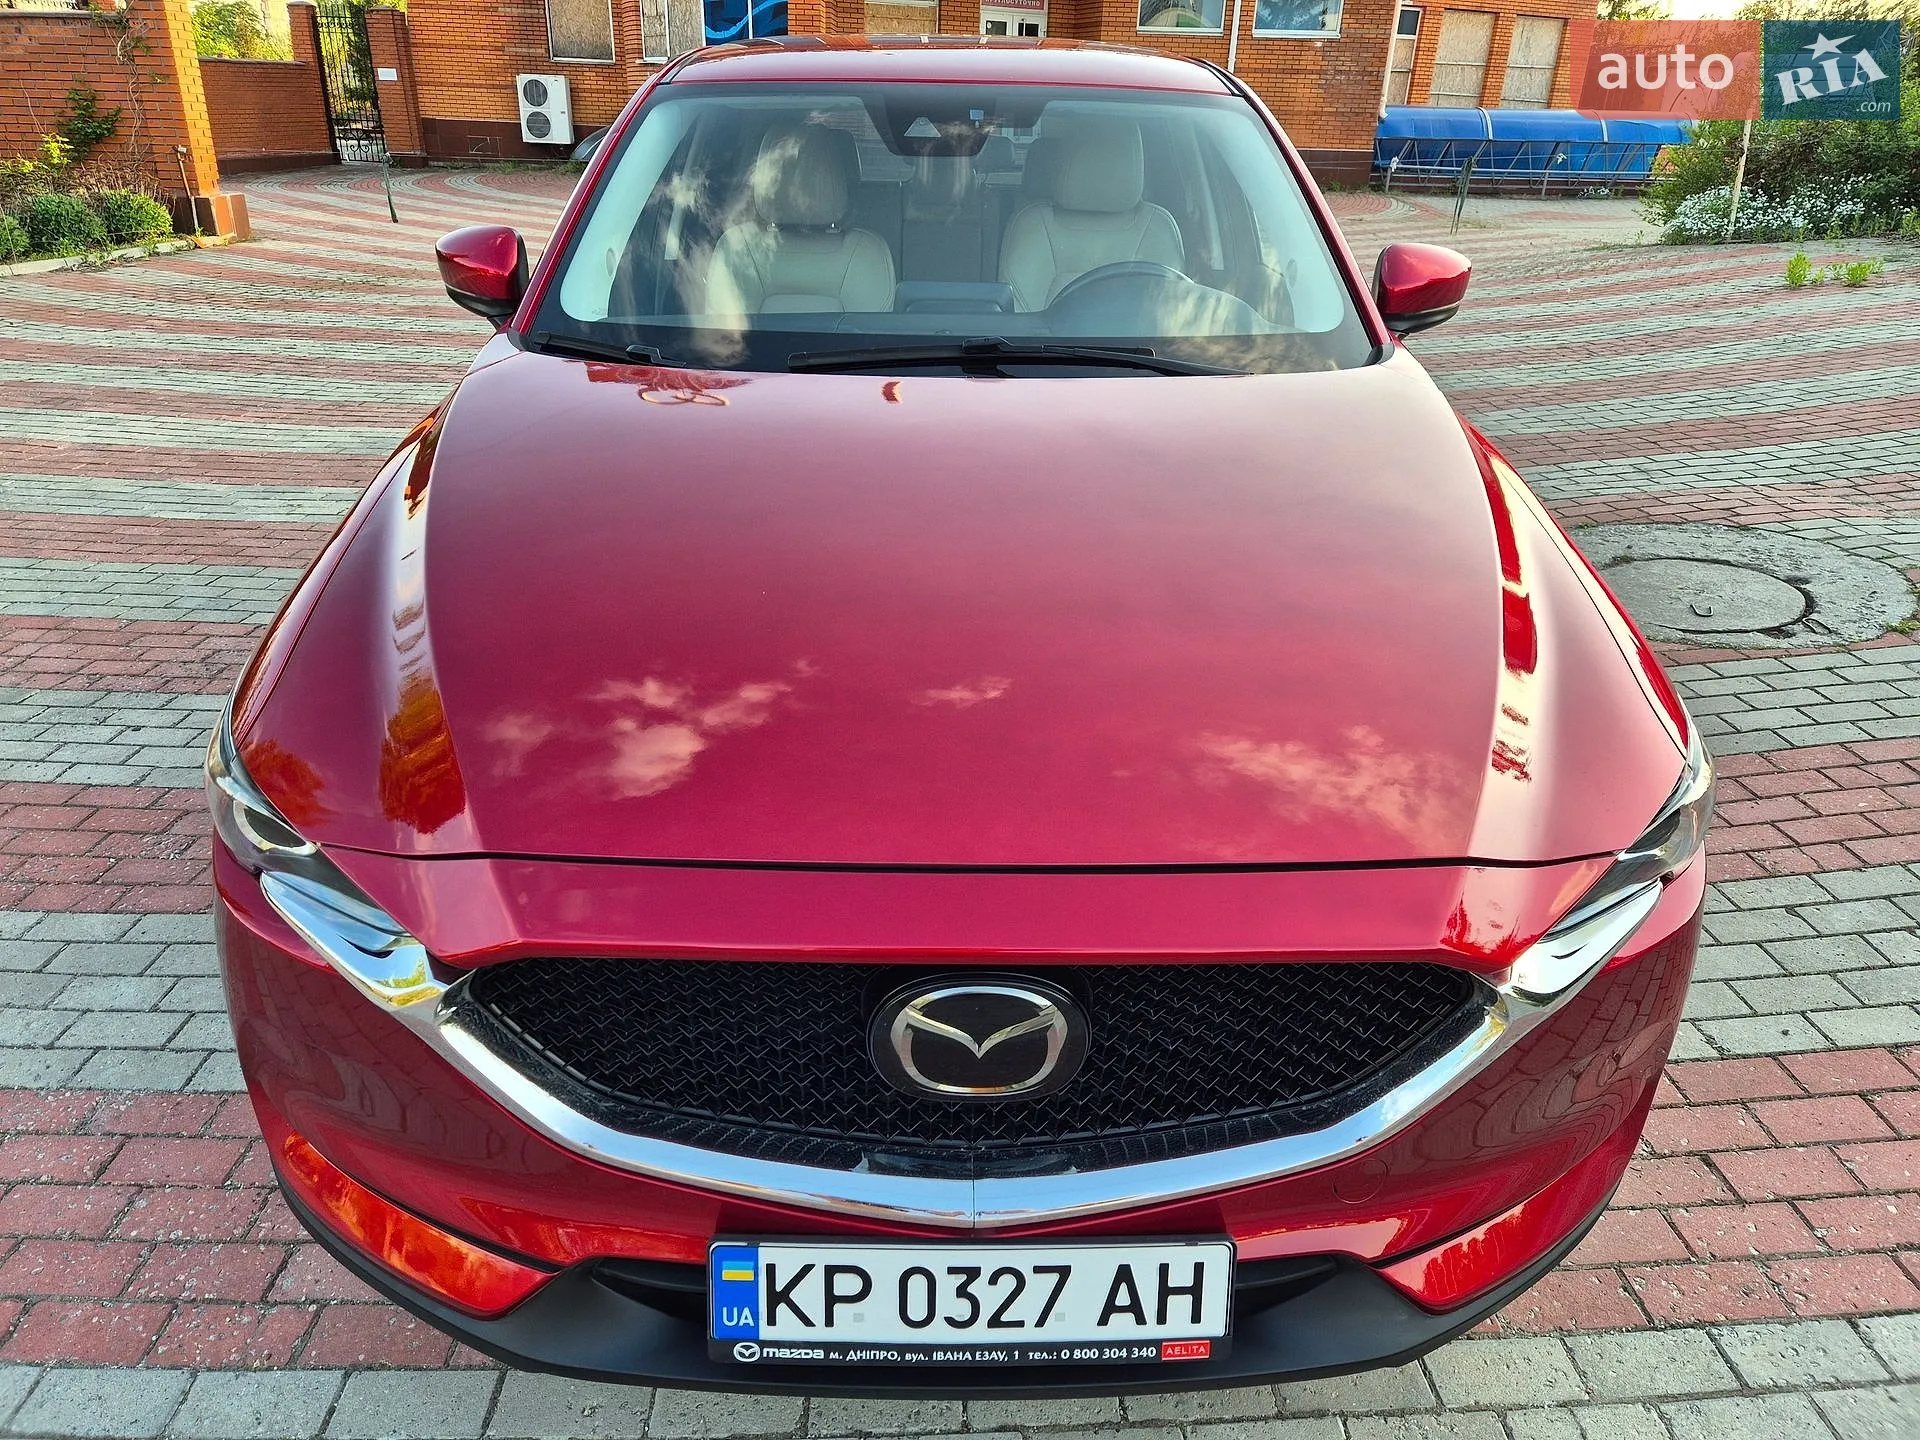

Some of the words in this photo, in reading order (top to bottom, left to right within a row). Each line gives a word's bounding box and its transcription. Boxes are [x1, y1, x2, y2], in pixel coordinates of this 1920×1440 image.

[765, 1263, 873, 1328] KP
[897, 1265, 1072, 1329] 0327
[1096, 1262, 1204, 1327] AH
[723, 1307, 755, 1327] UA
[829, 1351, 843, 1360] м.
[846, 1350, 901, 1362] ДНІПРО,
[905, 1352, 929, 1363] вул.
[932, 1350, 973, 1361] ІВАНА
[975, 1350, 1008, 1362] ЕЗАУ,
[1013, 1350, 1020, 1360] 1
[1027, 1351, 1057, 1360] тел.:
[1060, 1349, 1070, 1360] 0
[1073, 1348, 1099, 1360] 800
[1102, 1347, 1128, 1359] 304
[1131, 1346, 1157, 1358] 340
[1166, 1346, 1206, 1355] AELITA
